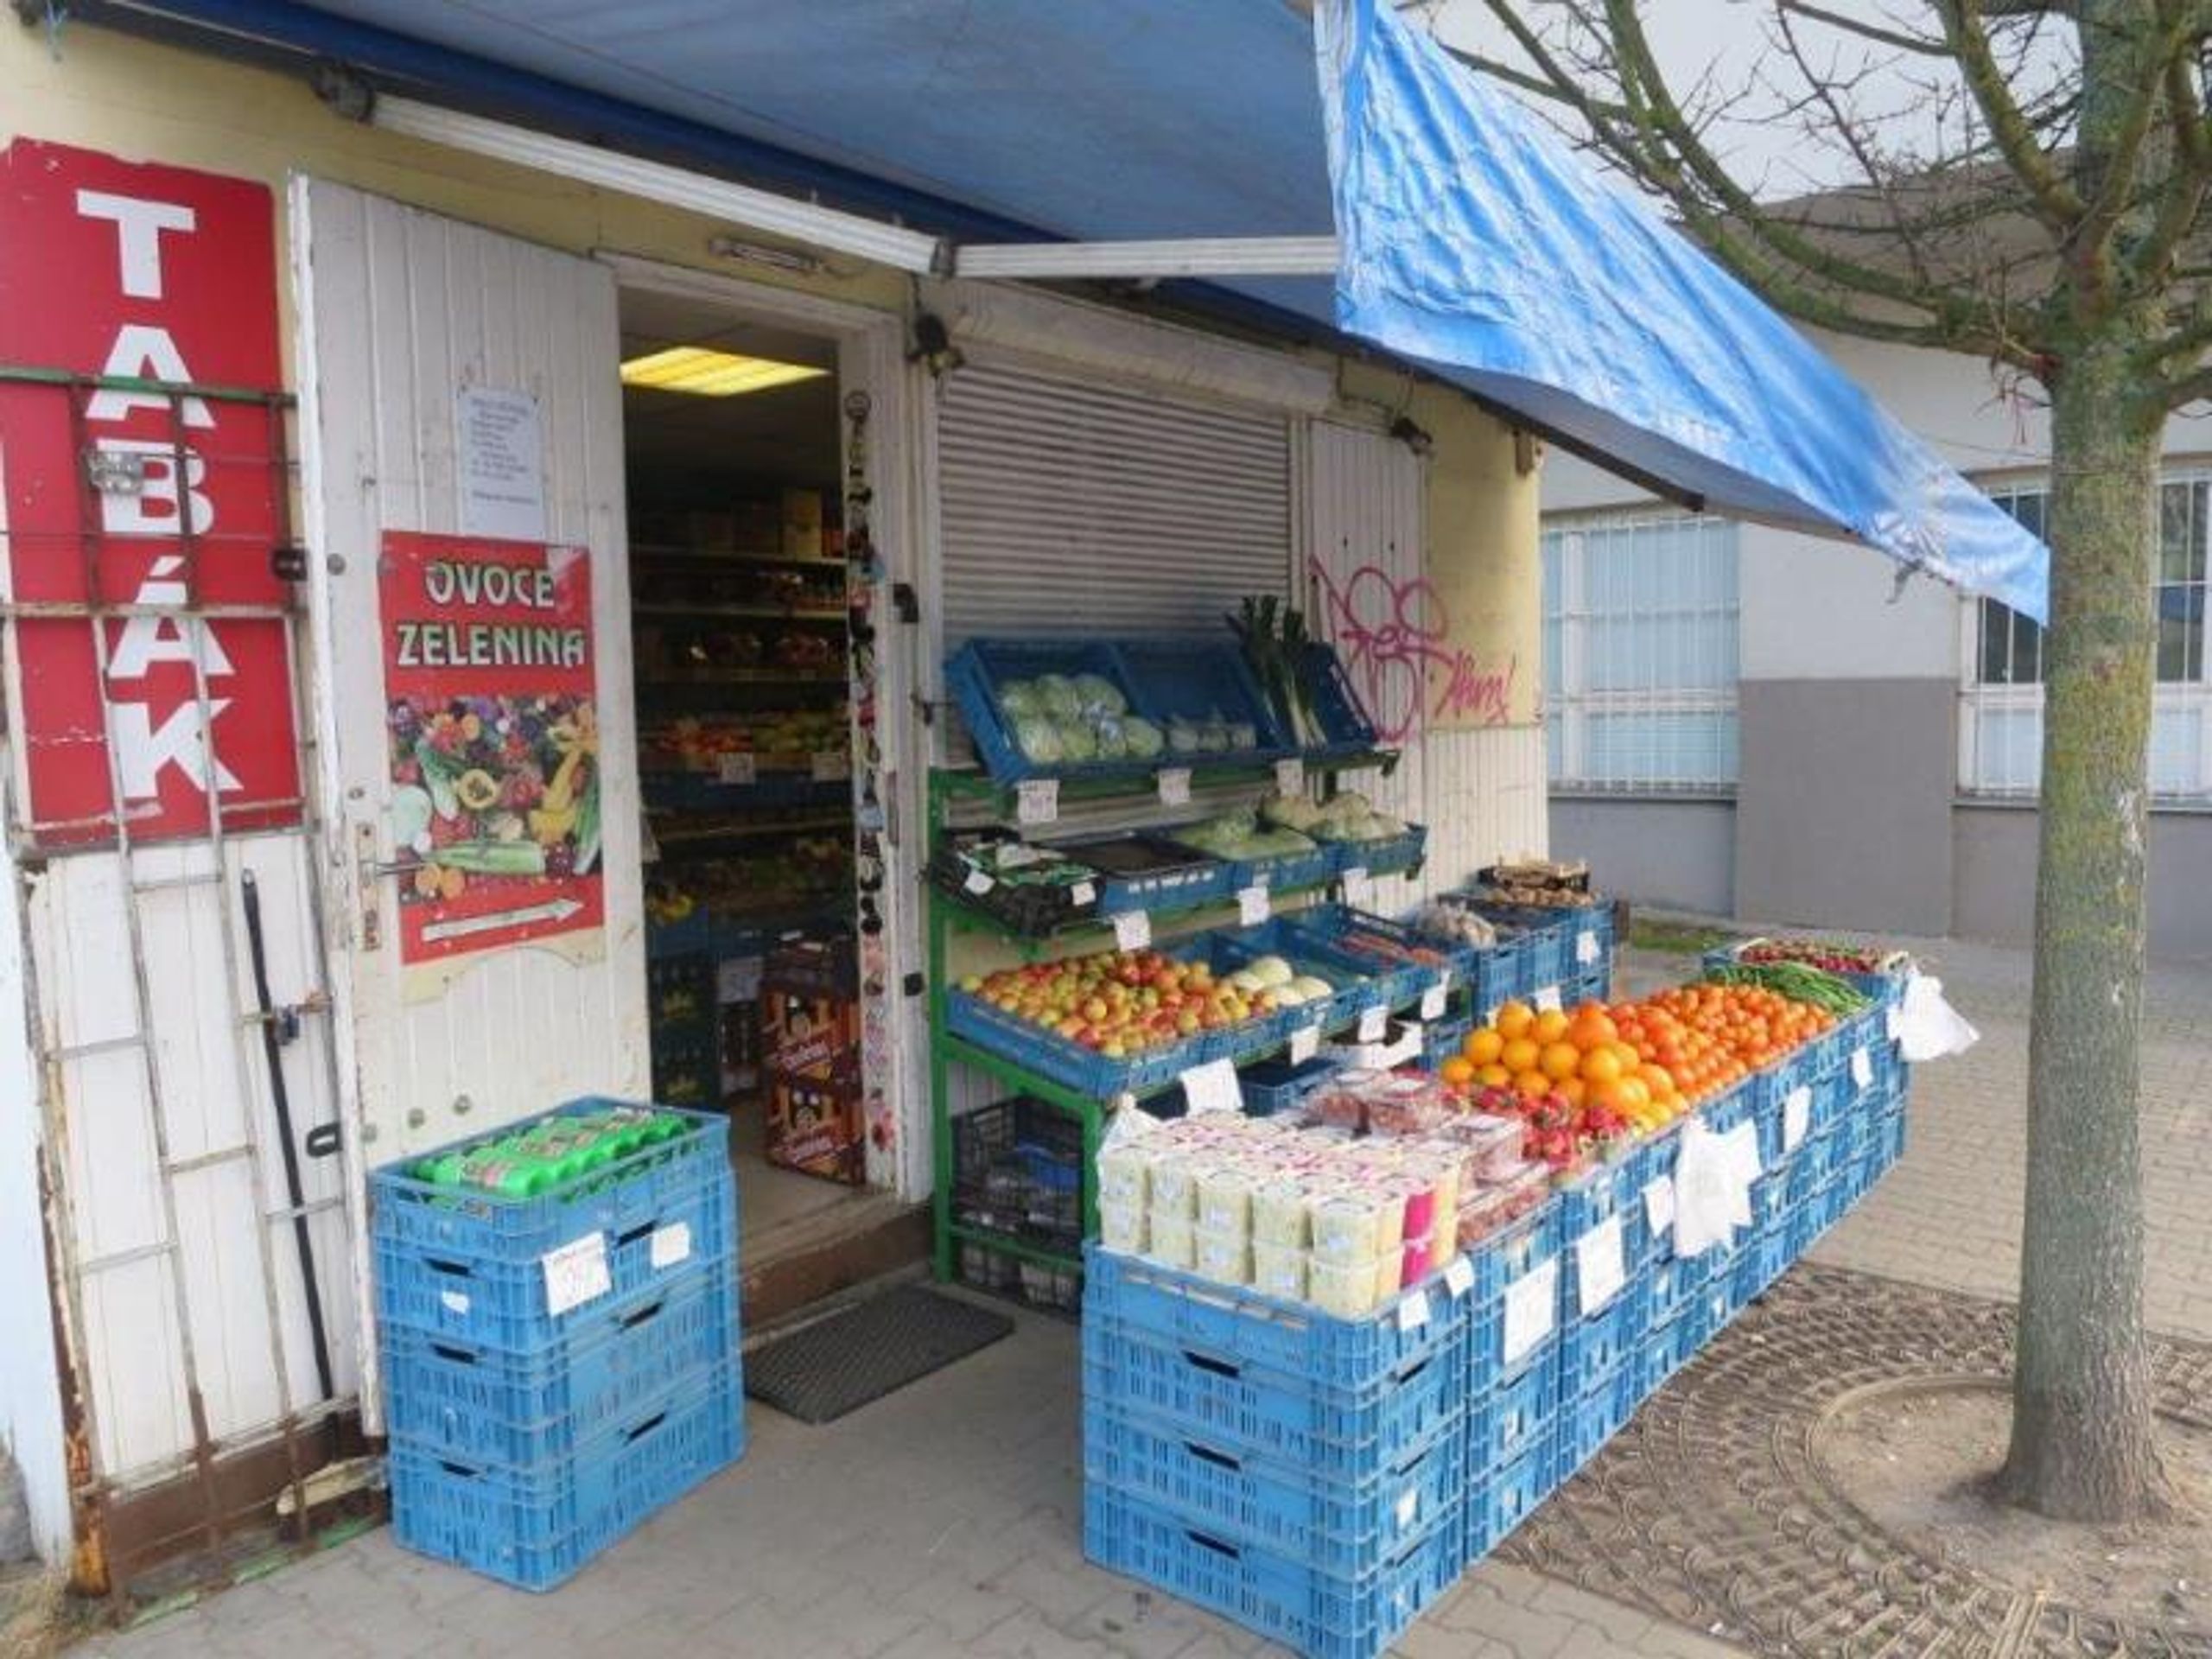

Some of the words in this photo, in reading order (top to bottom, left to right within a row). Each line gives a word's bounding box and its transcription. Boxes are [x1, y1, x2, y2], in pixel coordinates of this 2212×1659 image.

[76, 188, 243, 799] TABÁK
[425, 562, 555, 607] OVOCE
[397, 622, 585, 668] ZELENINA
